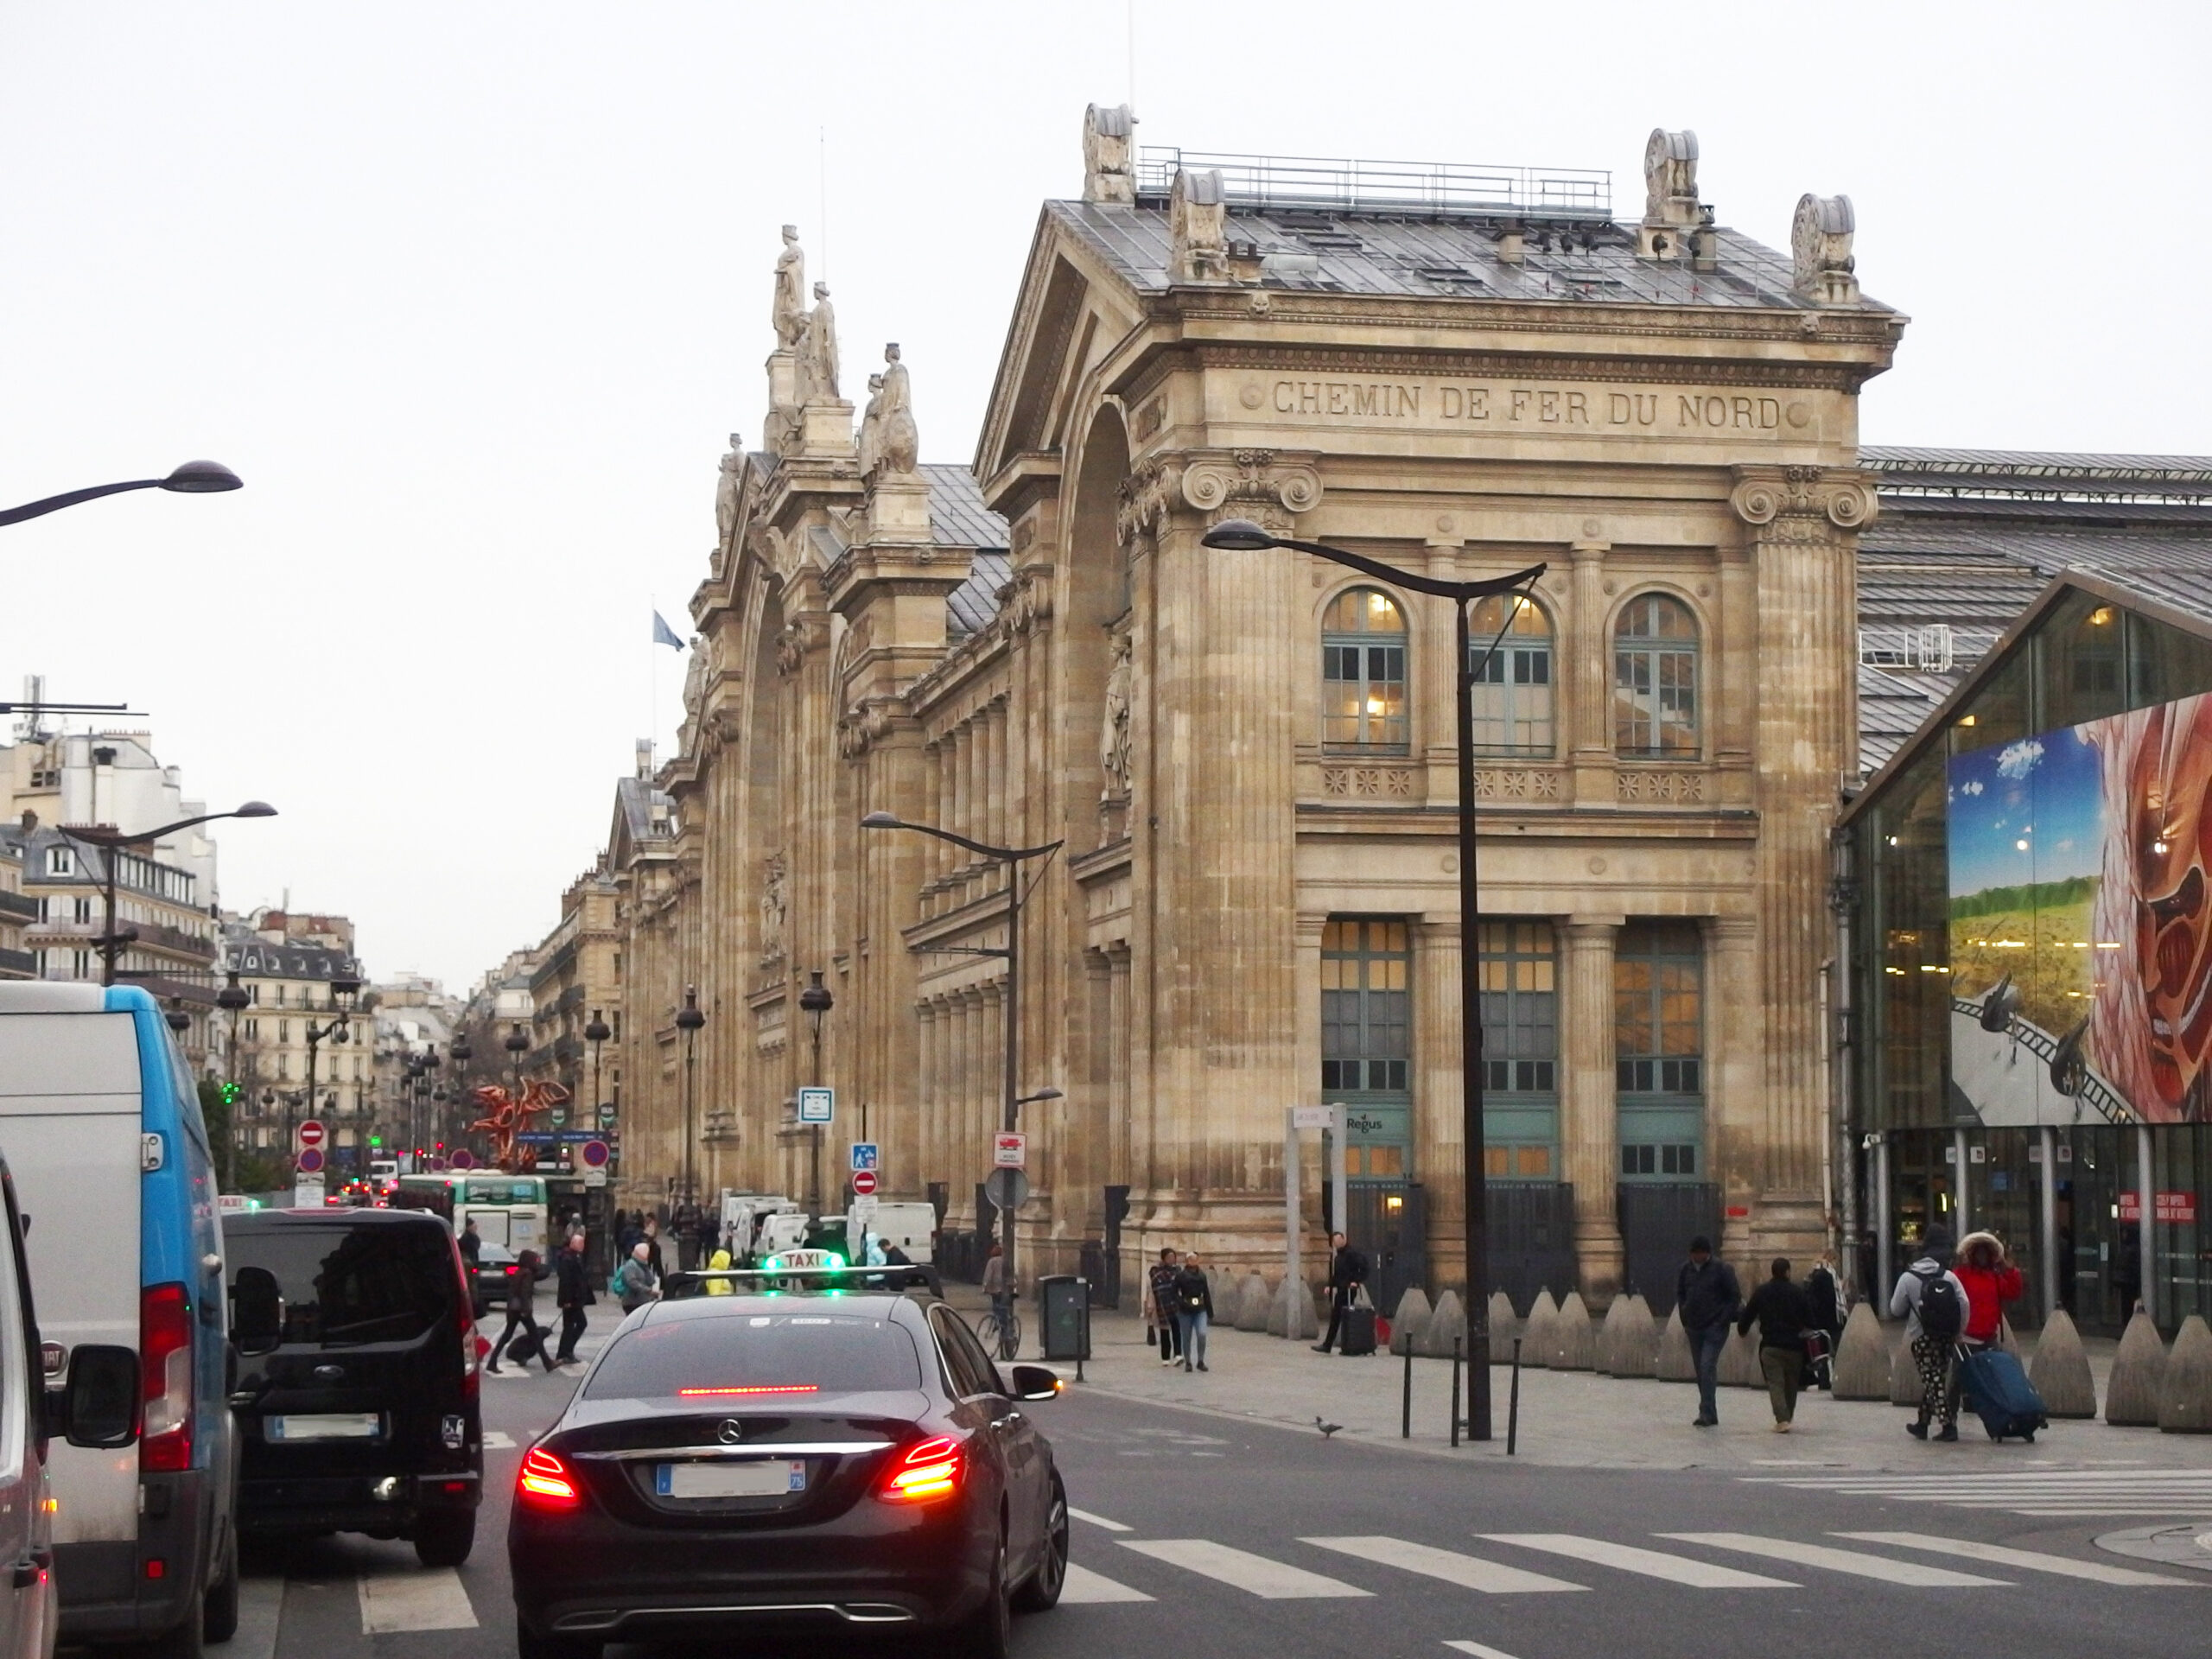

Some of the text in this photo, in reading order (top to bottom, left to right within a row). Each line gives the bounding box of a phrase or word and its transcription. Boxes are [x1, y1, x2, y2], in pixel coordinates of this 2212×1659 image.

[1273, 380, 1780, 429] CHEMIN DE FER DU NORD
[1347, 1116, 1382, 1134] Regus
[785, 1253, 820, 1268] TAXI
